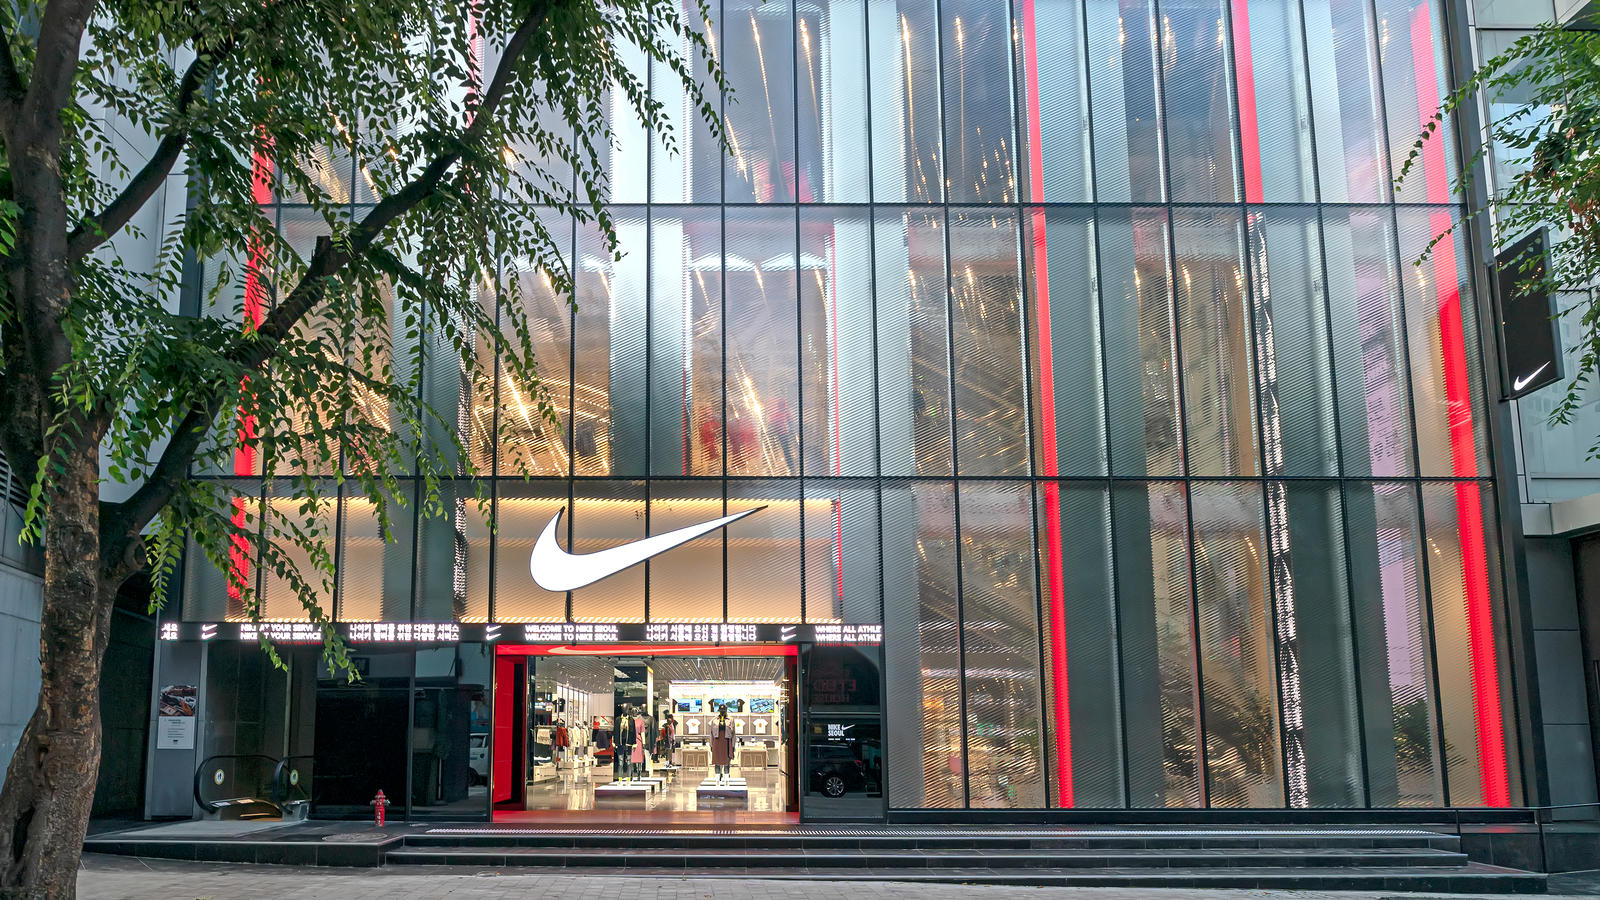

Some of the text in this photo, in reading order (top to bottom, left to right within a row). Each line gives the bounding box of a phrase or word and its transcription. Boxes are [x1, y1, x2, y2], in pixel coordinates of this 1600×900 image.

[271, 624, 291, 632] YOUR
[349, 624, 372, 632] 나이키
[437, 624, 460, 632] 서비스
[525, 624, 618, 632] WELCOME TO NIKE SEOUL
[646, 624, 668, 633] 나이키
[694, 624, 709, 633] 오신
[815, 625, 841, 633] WHERE
[843, 625, 857, 633] ALL
[271, 632, 291, 640] YOUR
[292, 632, 322, 640] SERVICE
[349, 632, 372, 640] 나이키
[437, 632, 460, 640] 서비스
[525, 633, 618, 641] WELCOME TO NIKE SEOUL
[646, 633, 668, 641] 나이키
[694, 633, 709, 641] 오신
[815, 633, 841, 641] WHERE
[843, 633, 857, 641] ALL
